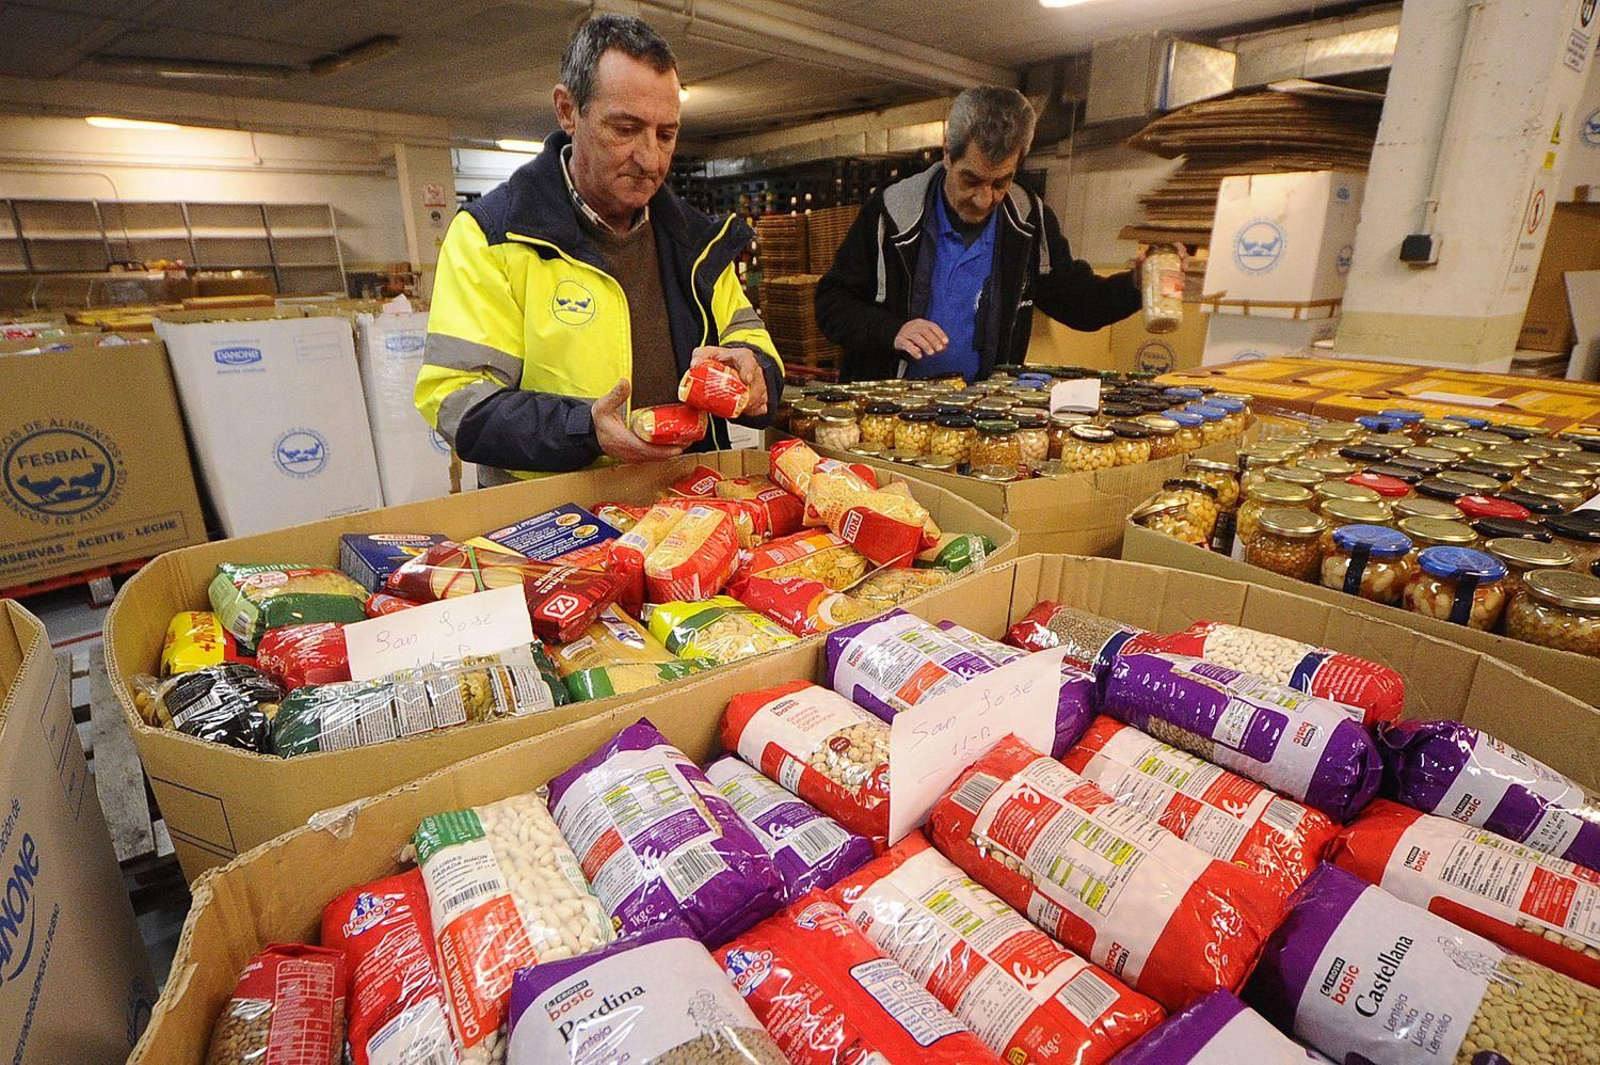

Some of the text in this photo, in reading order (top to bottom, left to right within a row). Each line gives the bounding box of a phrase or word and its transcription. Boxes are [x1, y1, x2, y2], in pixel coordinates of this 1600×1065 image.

[23, 419, 44, 434] DE
[17, 447, 94, 469] FESBAL
[846, 513, 861, 541] FROIZ
[0, 542, 65, 566] NSERVAS
[77, 530, 125, 549] ACEITE
[135, 519, 178, 537] LECHE
[375, 629, 418, 655] San
[910, 716, 956, 751] San
[1293, 721, 1314, 745] basic
[1459, 798, 1481, 823] basic
[1412, 850, 1431, 872] basic
[0, 832, 39, 988] ANONE
[630, 909, 649, 927] 1kg
[738, 949, 774, 987] engo
[1105, 941, 1121, 970] basic
[441, 930, 480, 1039] CATEGORIA EXTRA
[1326, 957, 1345, 990] EROSKI
[1331, 964, 1361, 1005] basic
[1354, 935, 1414, 1018] Castellana
[549, 987, 595, 1023] basic
[556, 980, 589, 1002] EROSKI
[1382, 993, 1409, 1032] Lenteja
[1037, 1038, 1060, 1058] 1kg
